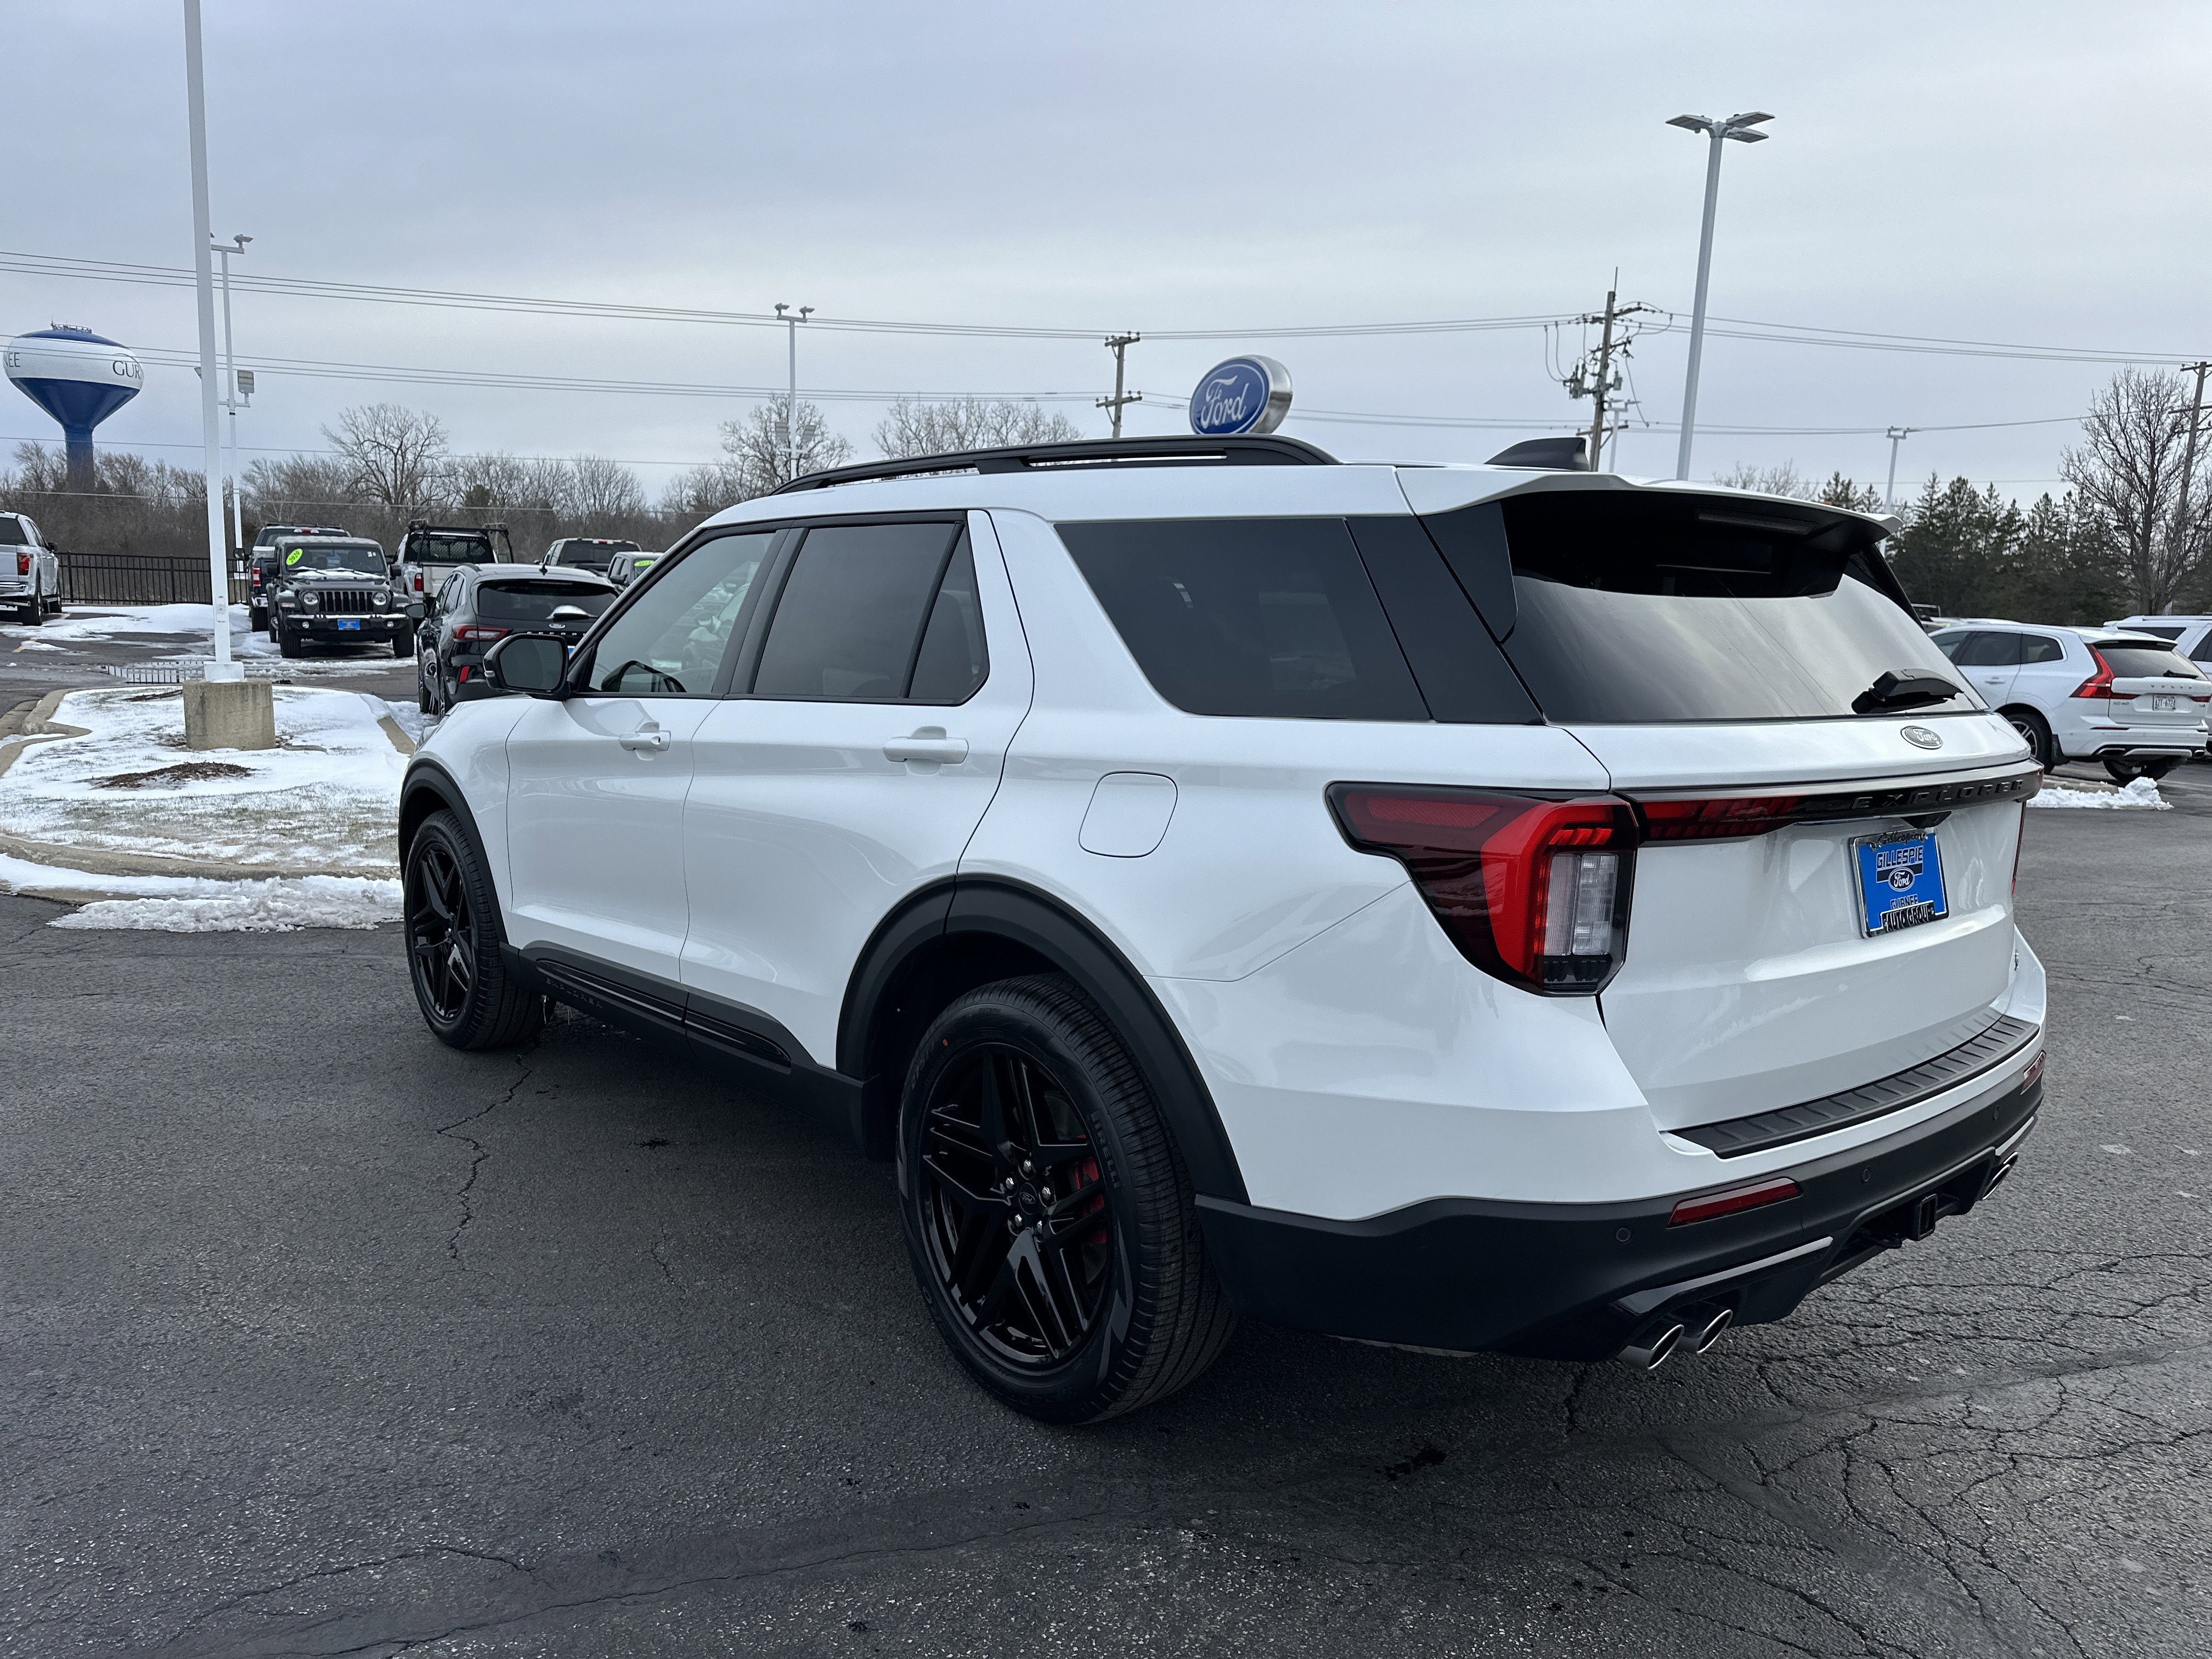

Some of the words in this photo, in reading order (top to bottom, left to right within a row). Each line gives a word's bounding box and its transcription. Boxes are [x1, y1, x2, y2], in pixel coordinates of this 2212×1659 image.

[1200, 375, 1249, 429] Ford
[1913, 729, 1937, 742] Ford
[1852, 779, 2023, 809] EXPLORER
[1876, 845, 1923, 868] GILLESPIE
[1893, 871, 1909, 887] Ford
